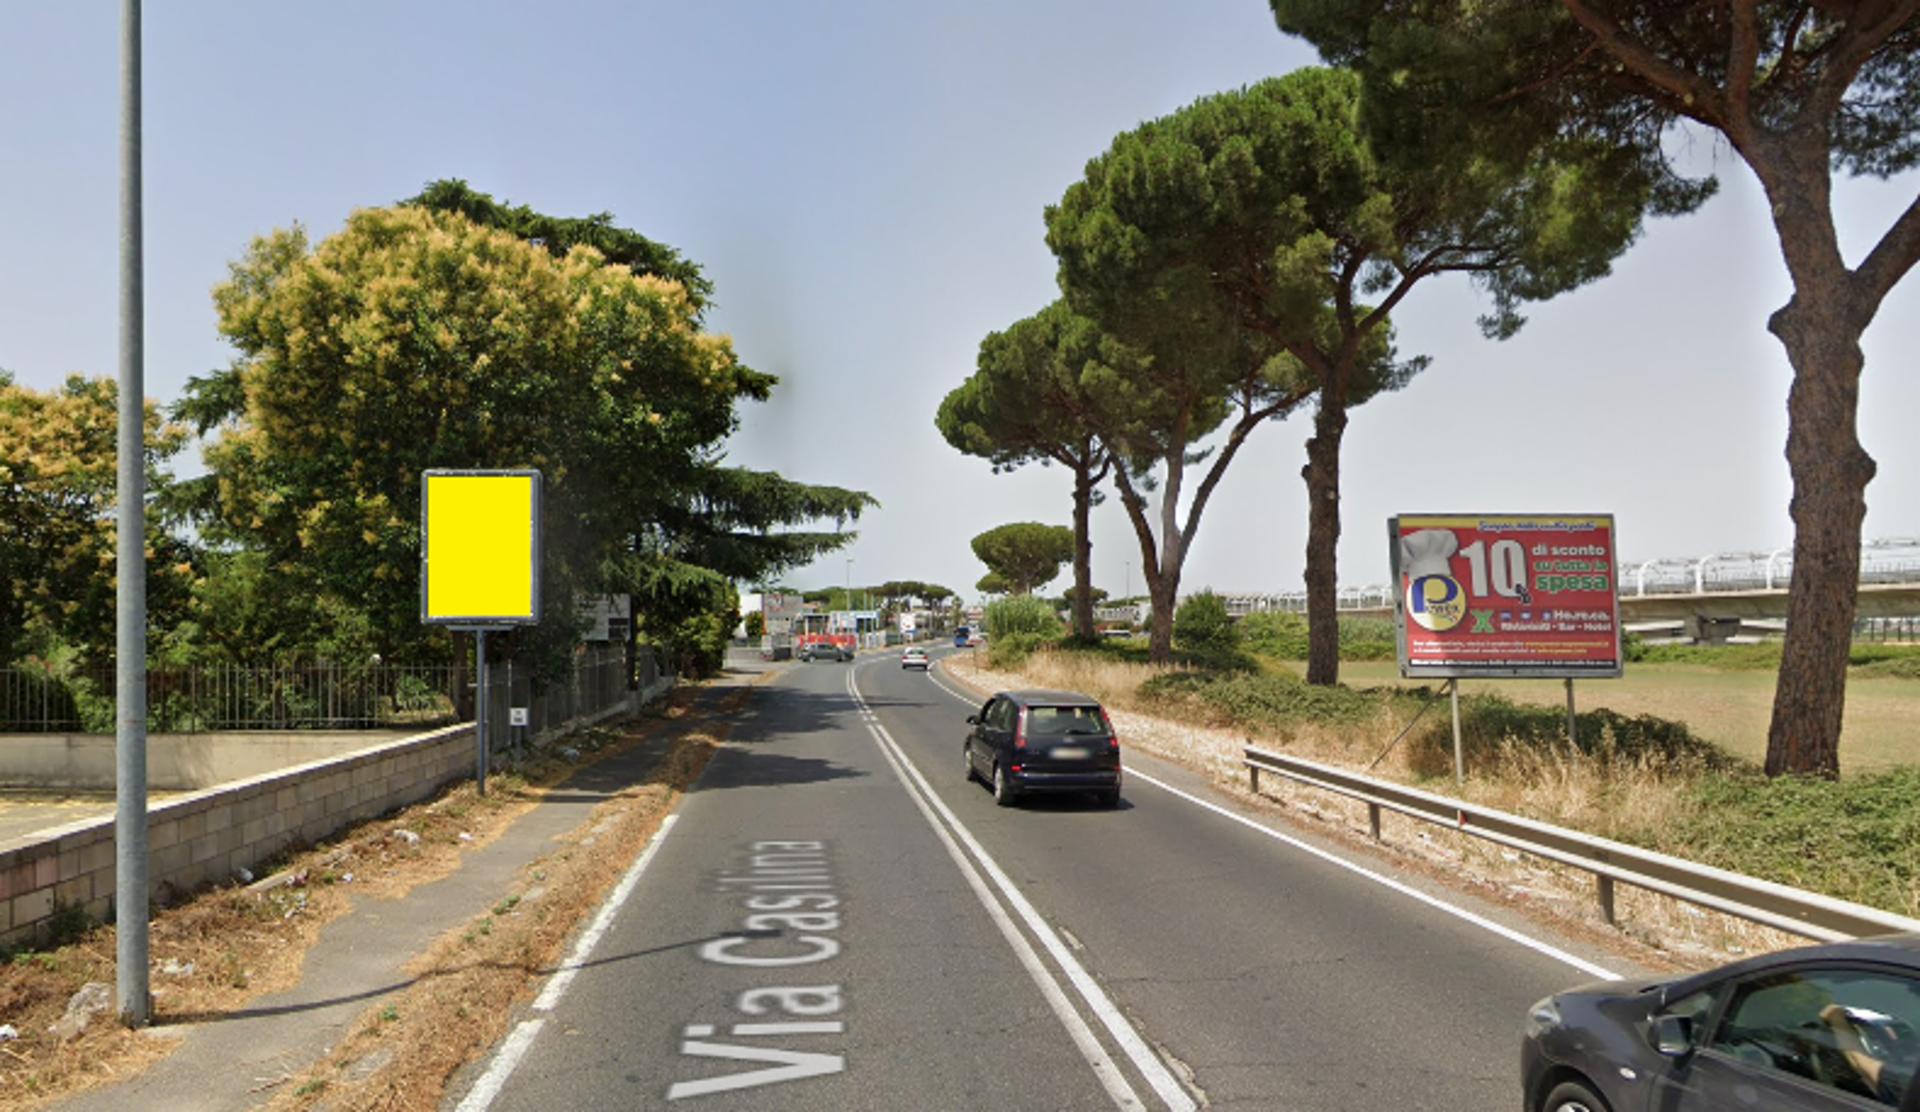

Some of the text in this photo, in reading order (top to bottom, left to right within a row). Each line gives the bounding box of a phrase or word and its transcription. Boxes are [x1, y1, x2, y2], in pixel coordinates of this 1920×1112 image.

[1532, 544, 1606, 556] di sconto
[1536, 575, 1609, 594] spesa
